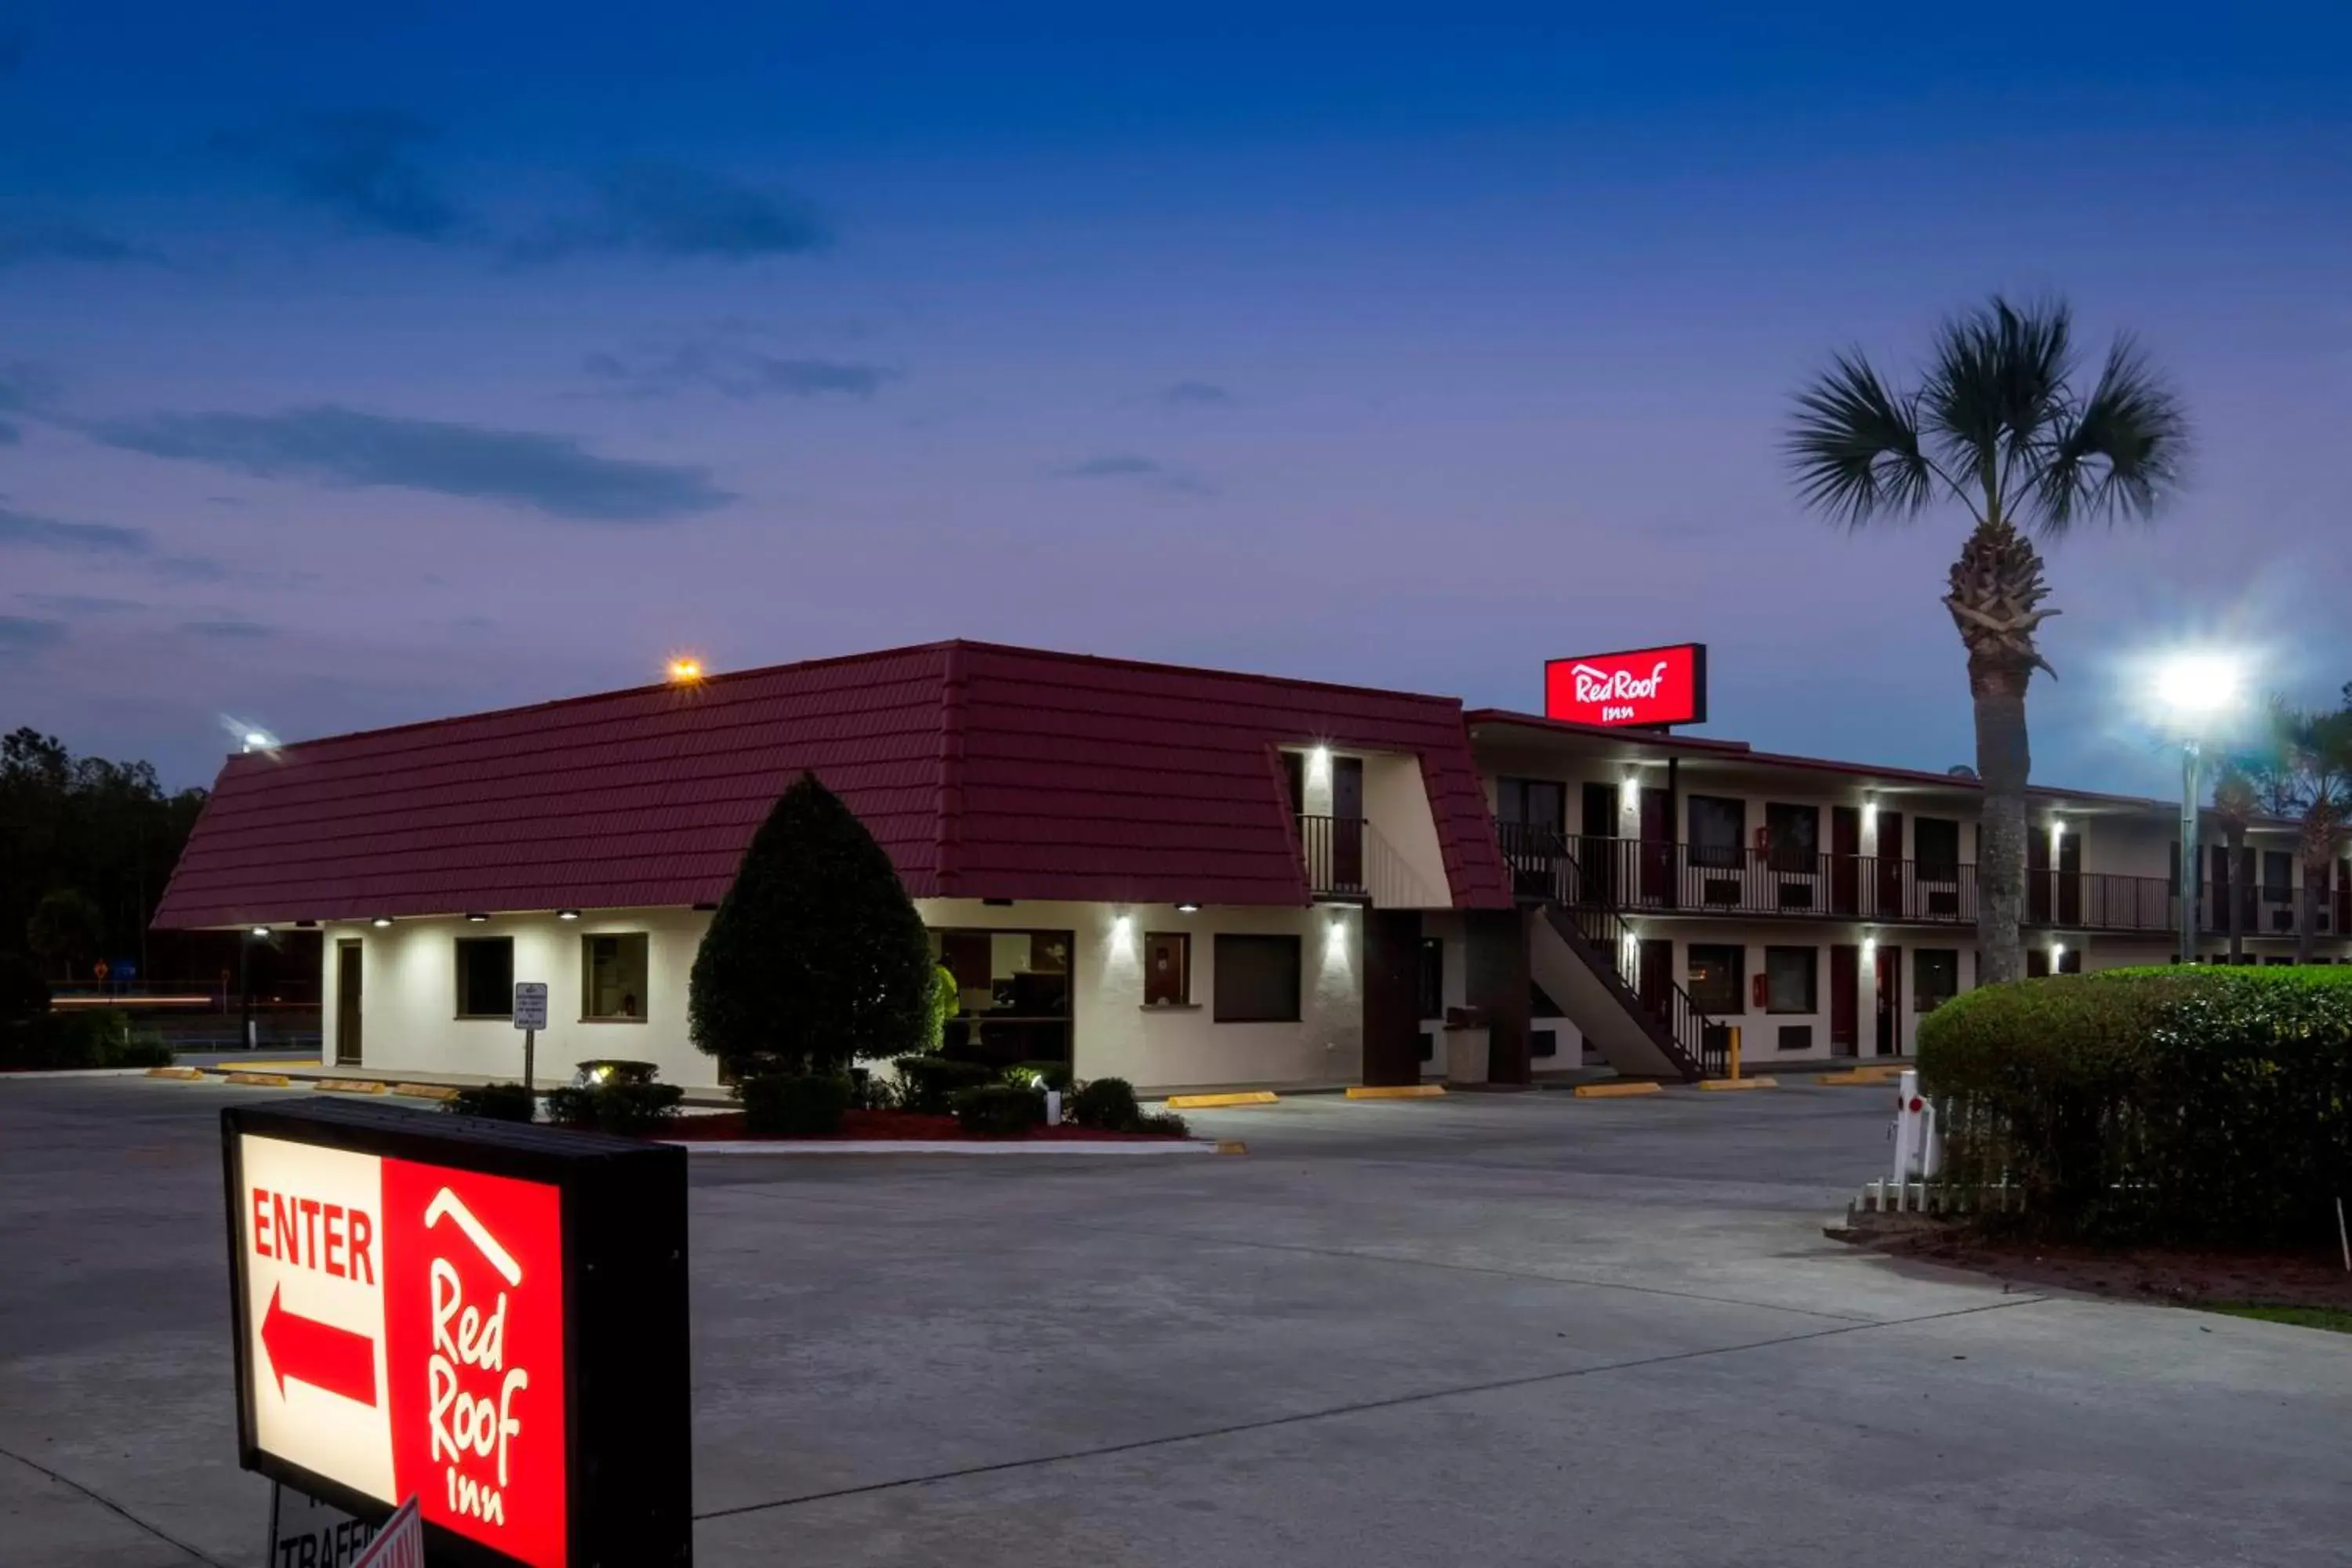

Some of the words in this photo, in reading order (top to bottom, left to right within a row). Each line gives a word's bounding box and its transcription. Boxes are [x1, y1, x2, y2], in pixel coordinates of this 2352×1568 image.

[1576, 673, 1614, 702] Red
[1614, 662, 1668, 699] Roof
[1602, 706, 1635, 722] Inn
[252, 1188, 375, 1286] ENTER
[430, 1257, 507, 1372] Red
[428, 1353, 528, 1488] Roof
[446, 1466, 505, 1526] Inn
